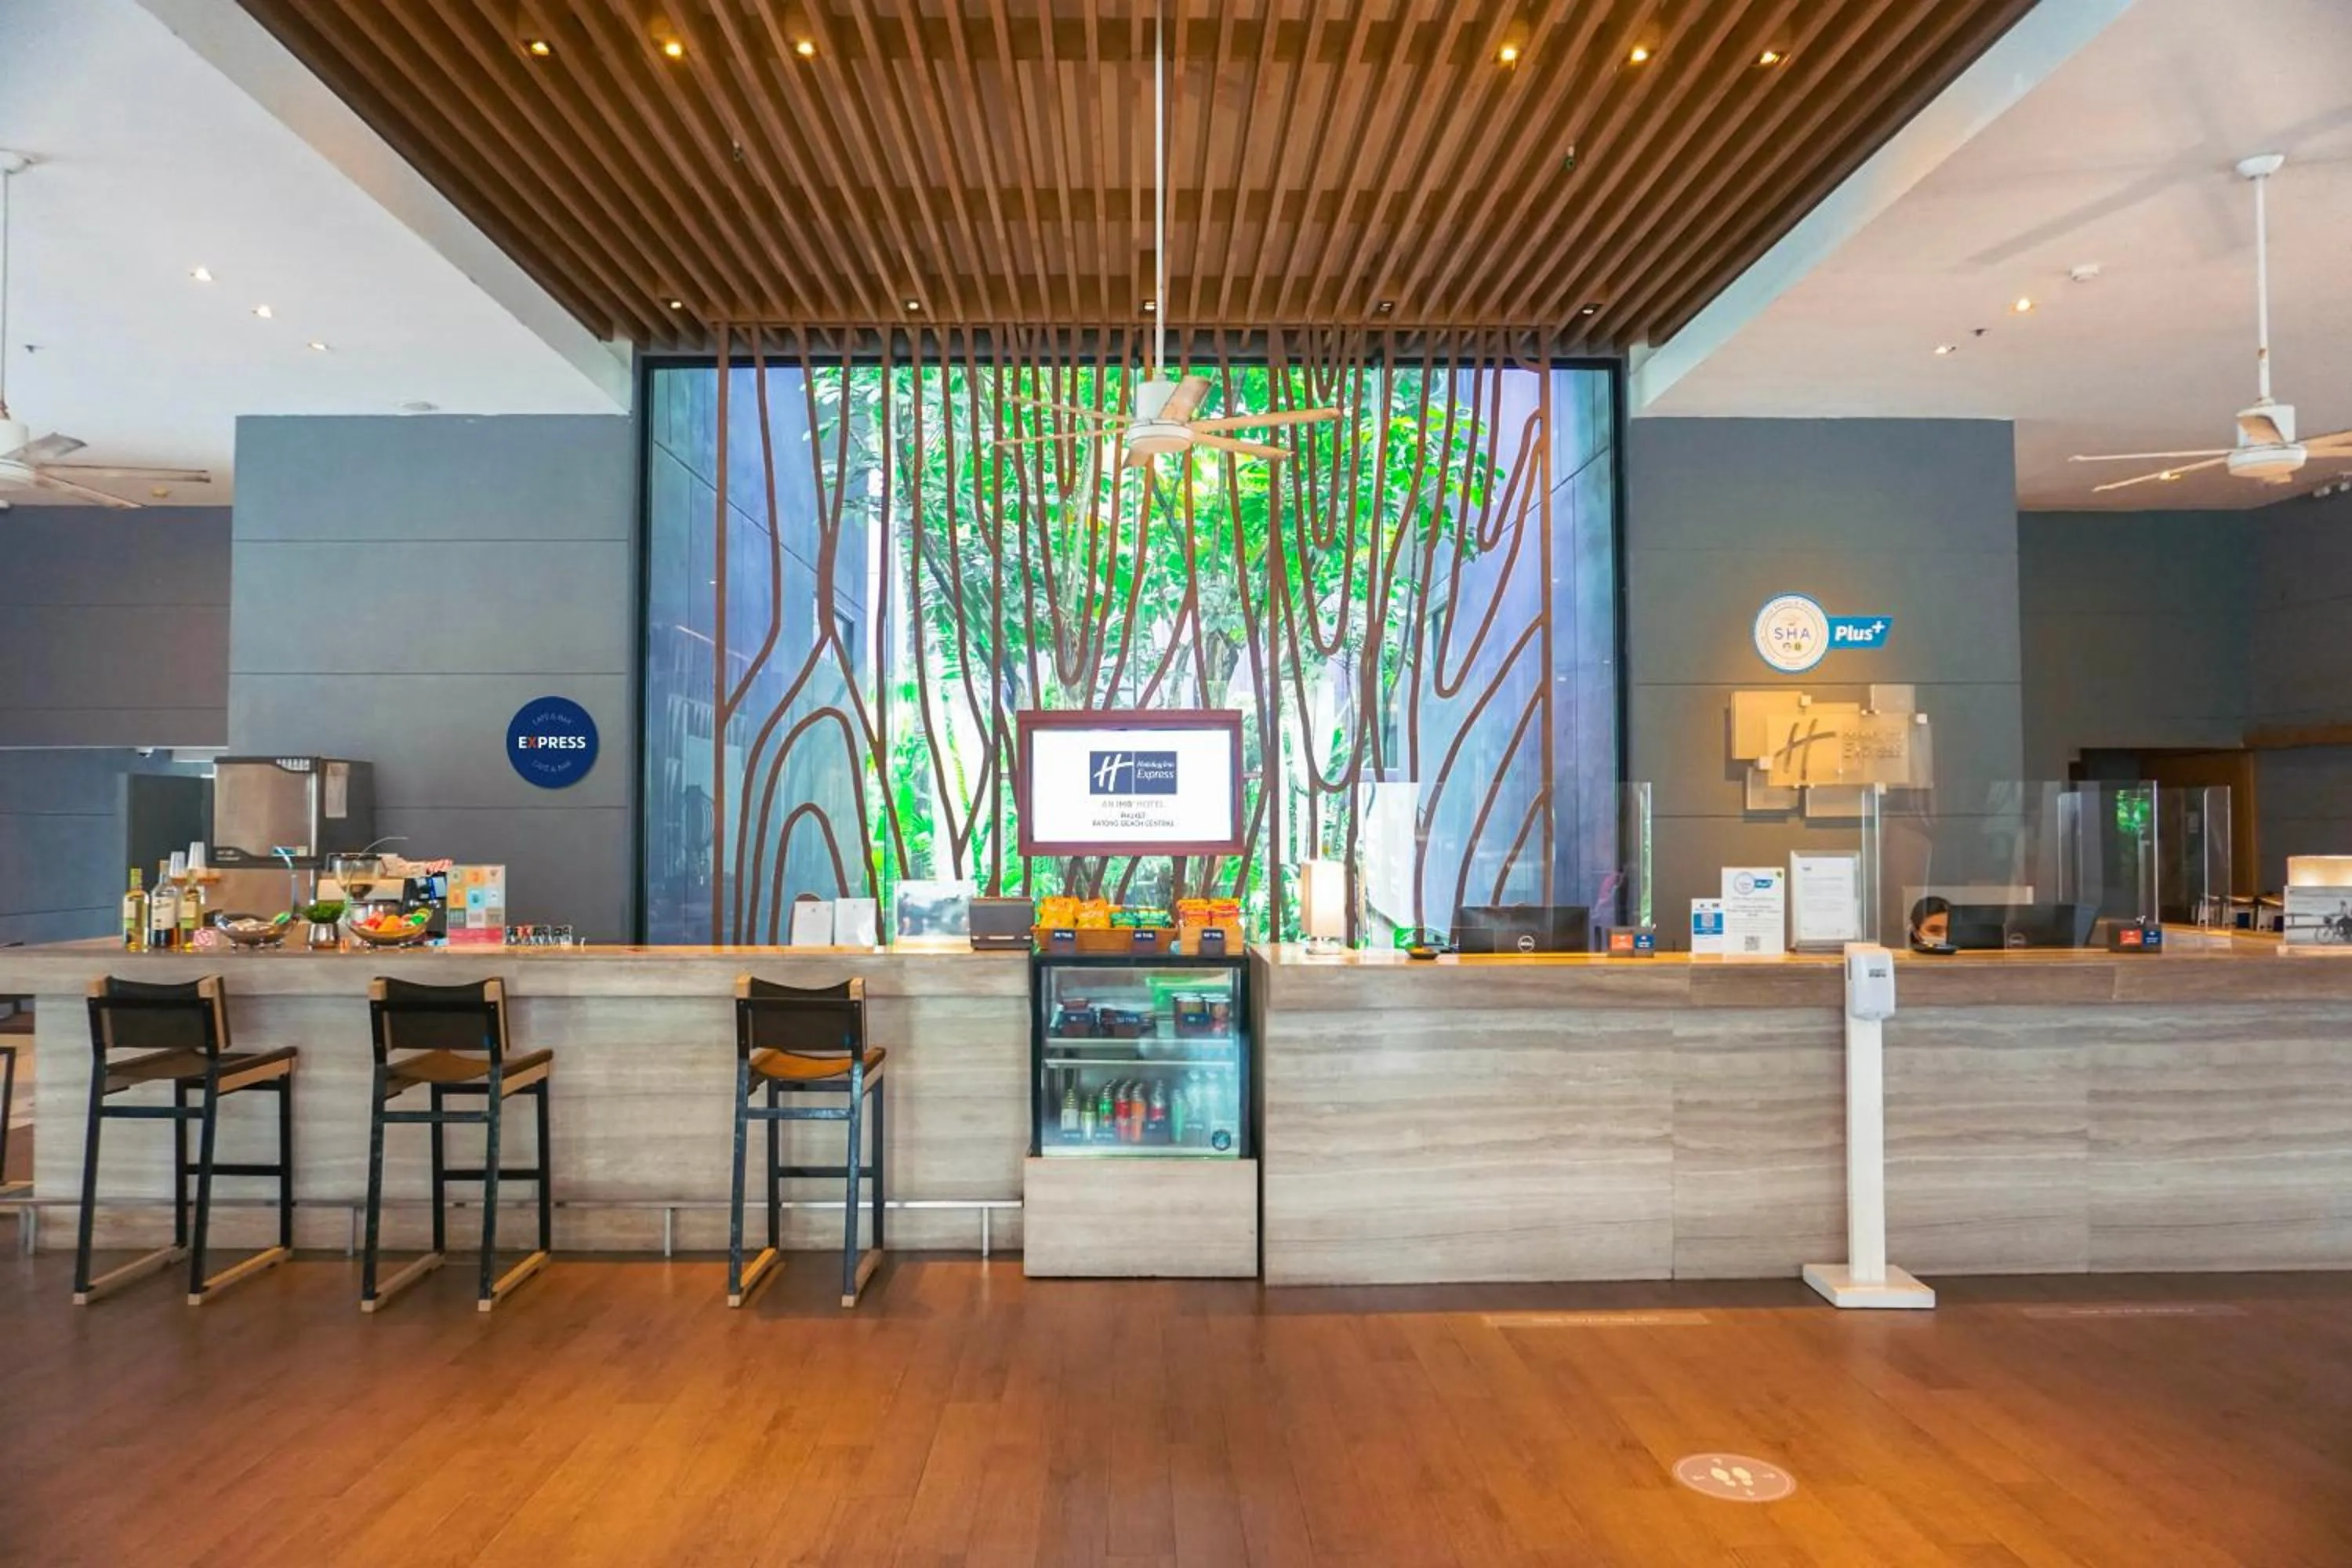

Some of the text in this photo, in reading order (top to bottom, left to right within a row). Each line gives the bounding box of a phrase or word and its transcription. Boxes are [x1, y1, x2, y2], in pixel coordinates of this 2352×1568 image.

[1774, 627, 1811, 641] SHA
[518, 736, 586, 749] EXPRESS
[1137, 768, 1174, 780] Express
